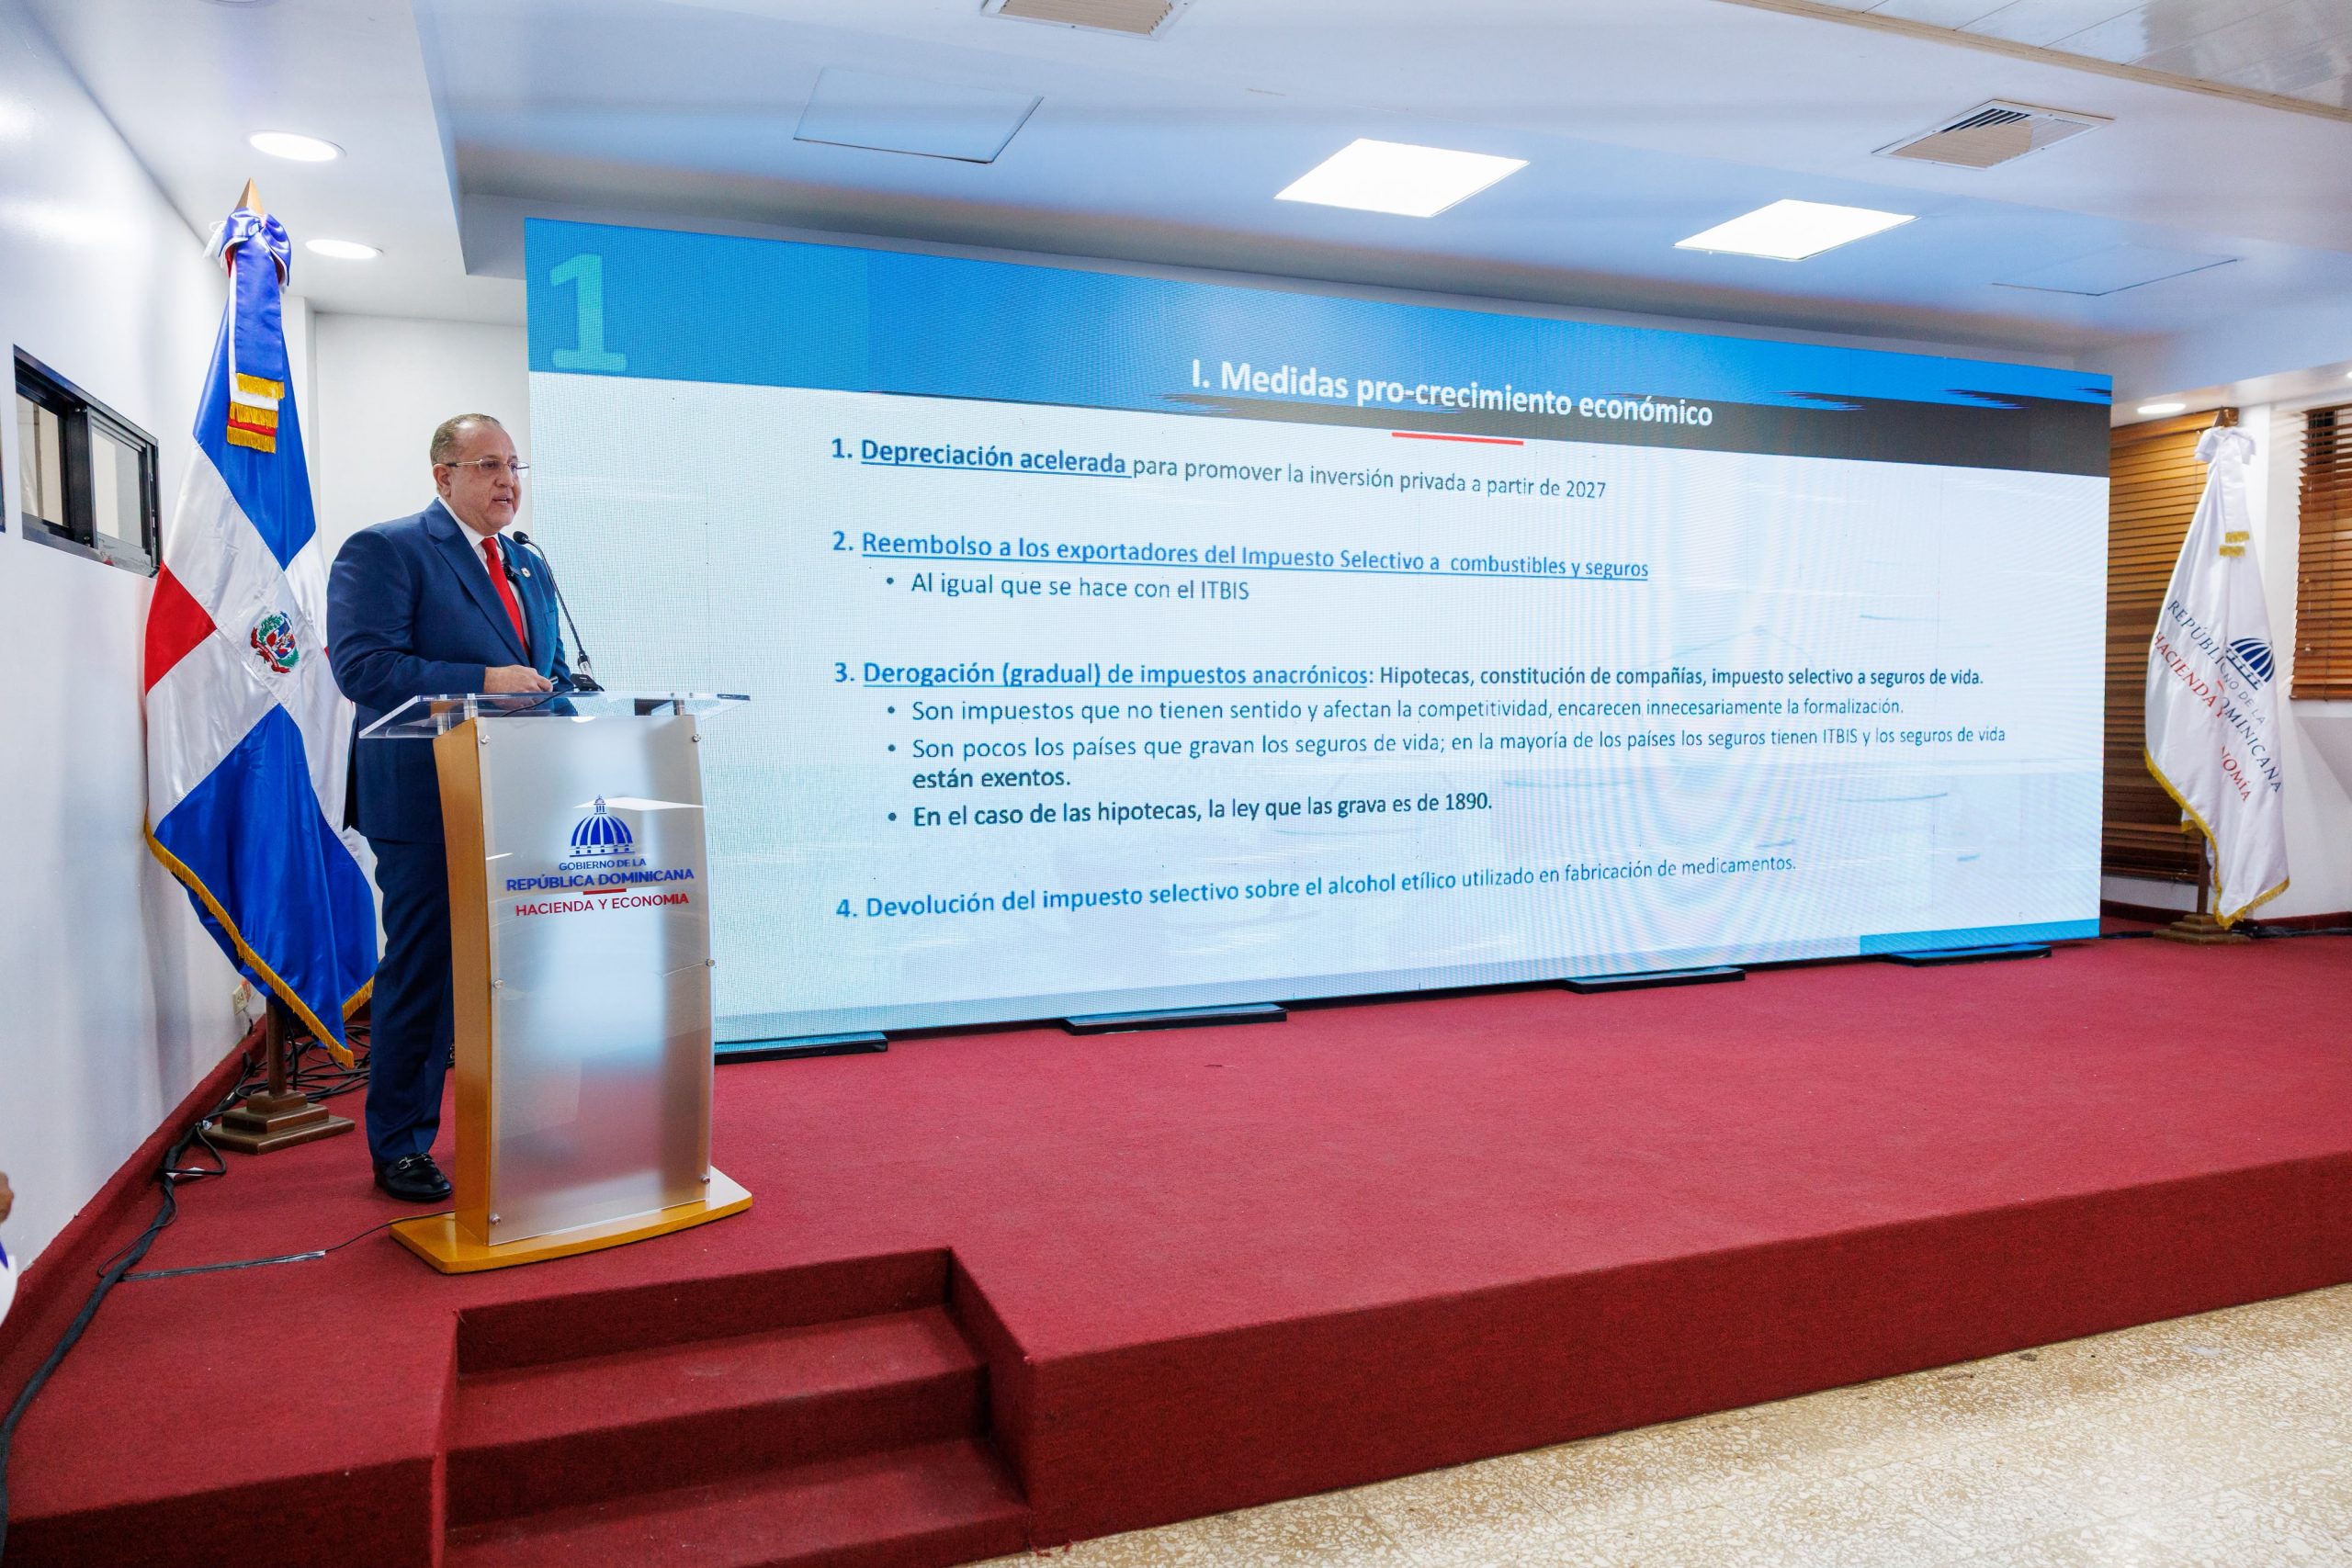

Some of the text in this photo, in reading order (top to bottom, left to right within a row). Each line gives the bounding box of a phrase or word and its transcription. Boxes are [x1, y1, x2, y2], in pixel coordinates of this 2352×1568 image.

[548, 253, 628, 373] 1
[1193, 359, 1713, 426] I. Medidas pro-crecimiento económico
[831, 438, 1606, 499] 1. Depreciación acelerada para promover la inversión privada a partir de 2027
[832, 532, 1648, 579] 2. Reembolso a los exportadores del Impuesto Selectivo a combustibles y seguros
[911, 572, 1250, 601] Al igual que se hace con el ITBIS
[834, 661, 1984, 688] 3. Derogación (gradual) de impuestos anacrónicos: Hipotecas, constitución de compañías, impuesto selectivo a seguros de vida.
[912, 696, 1904, 724] Son impuestos que no tienen sentido y afectan la competitividad, encarecen innecesariamente la formalización.
[2239, 691, 2266, 724] DE LA
[912, 727, 2005, 761] Son pocos los países que gravan los seguros de vida; en la mayoría de los países los seguros tienen ITBIS y los seguros de vida
[2222, 696, 2281, 793] OMINICANA
[912, 769, 1071, 789] están exentos.
[913, 792, 1492, 827] En el caso de las hipotecas, la ley que las grava es de 1890.
[506, 869, 694, 891] REPÚBLICA DOMINICANA
[559, 860, 616, 871] GOBIERNO
[634, 858, 646, 866] LA
[836, 856, 1795, 919] 4. Devolución del impuesto selectivo sobre el alcohol etílico utilizado en fabricación de medicamentos.
[515, 893, 689, 916] HACIENDA Y ECONOMIA
